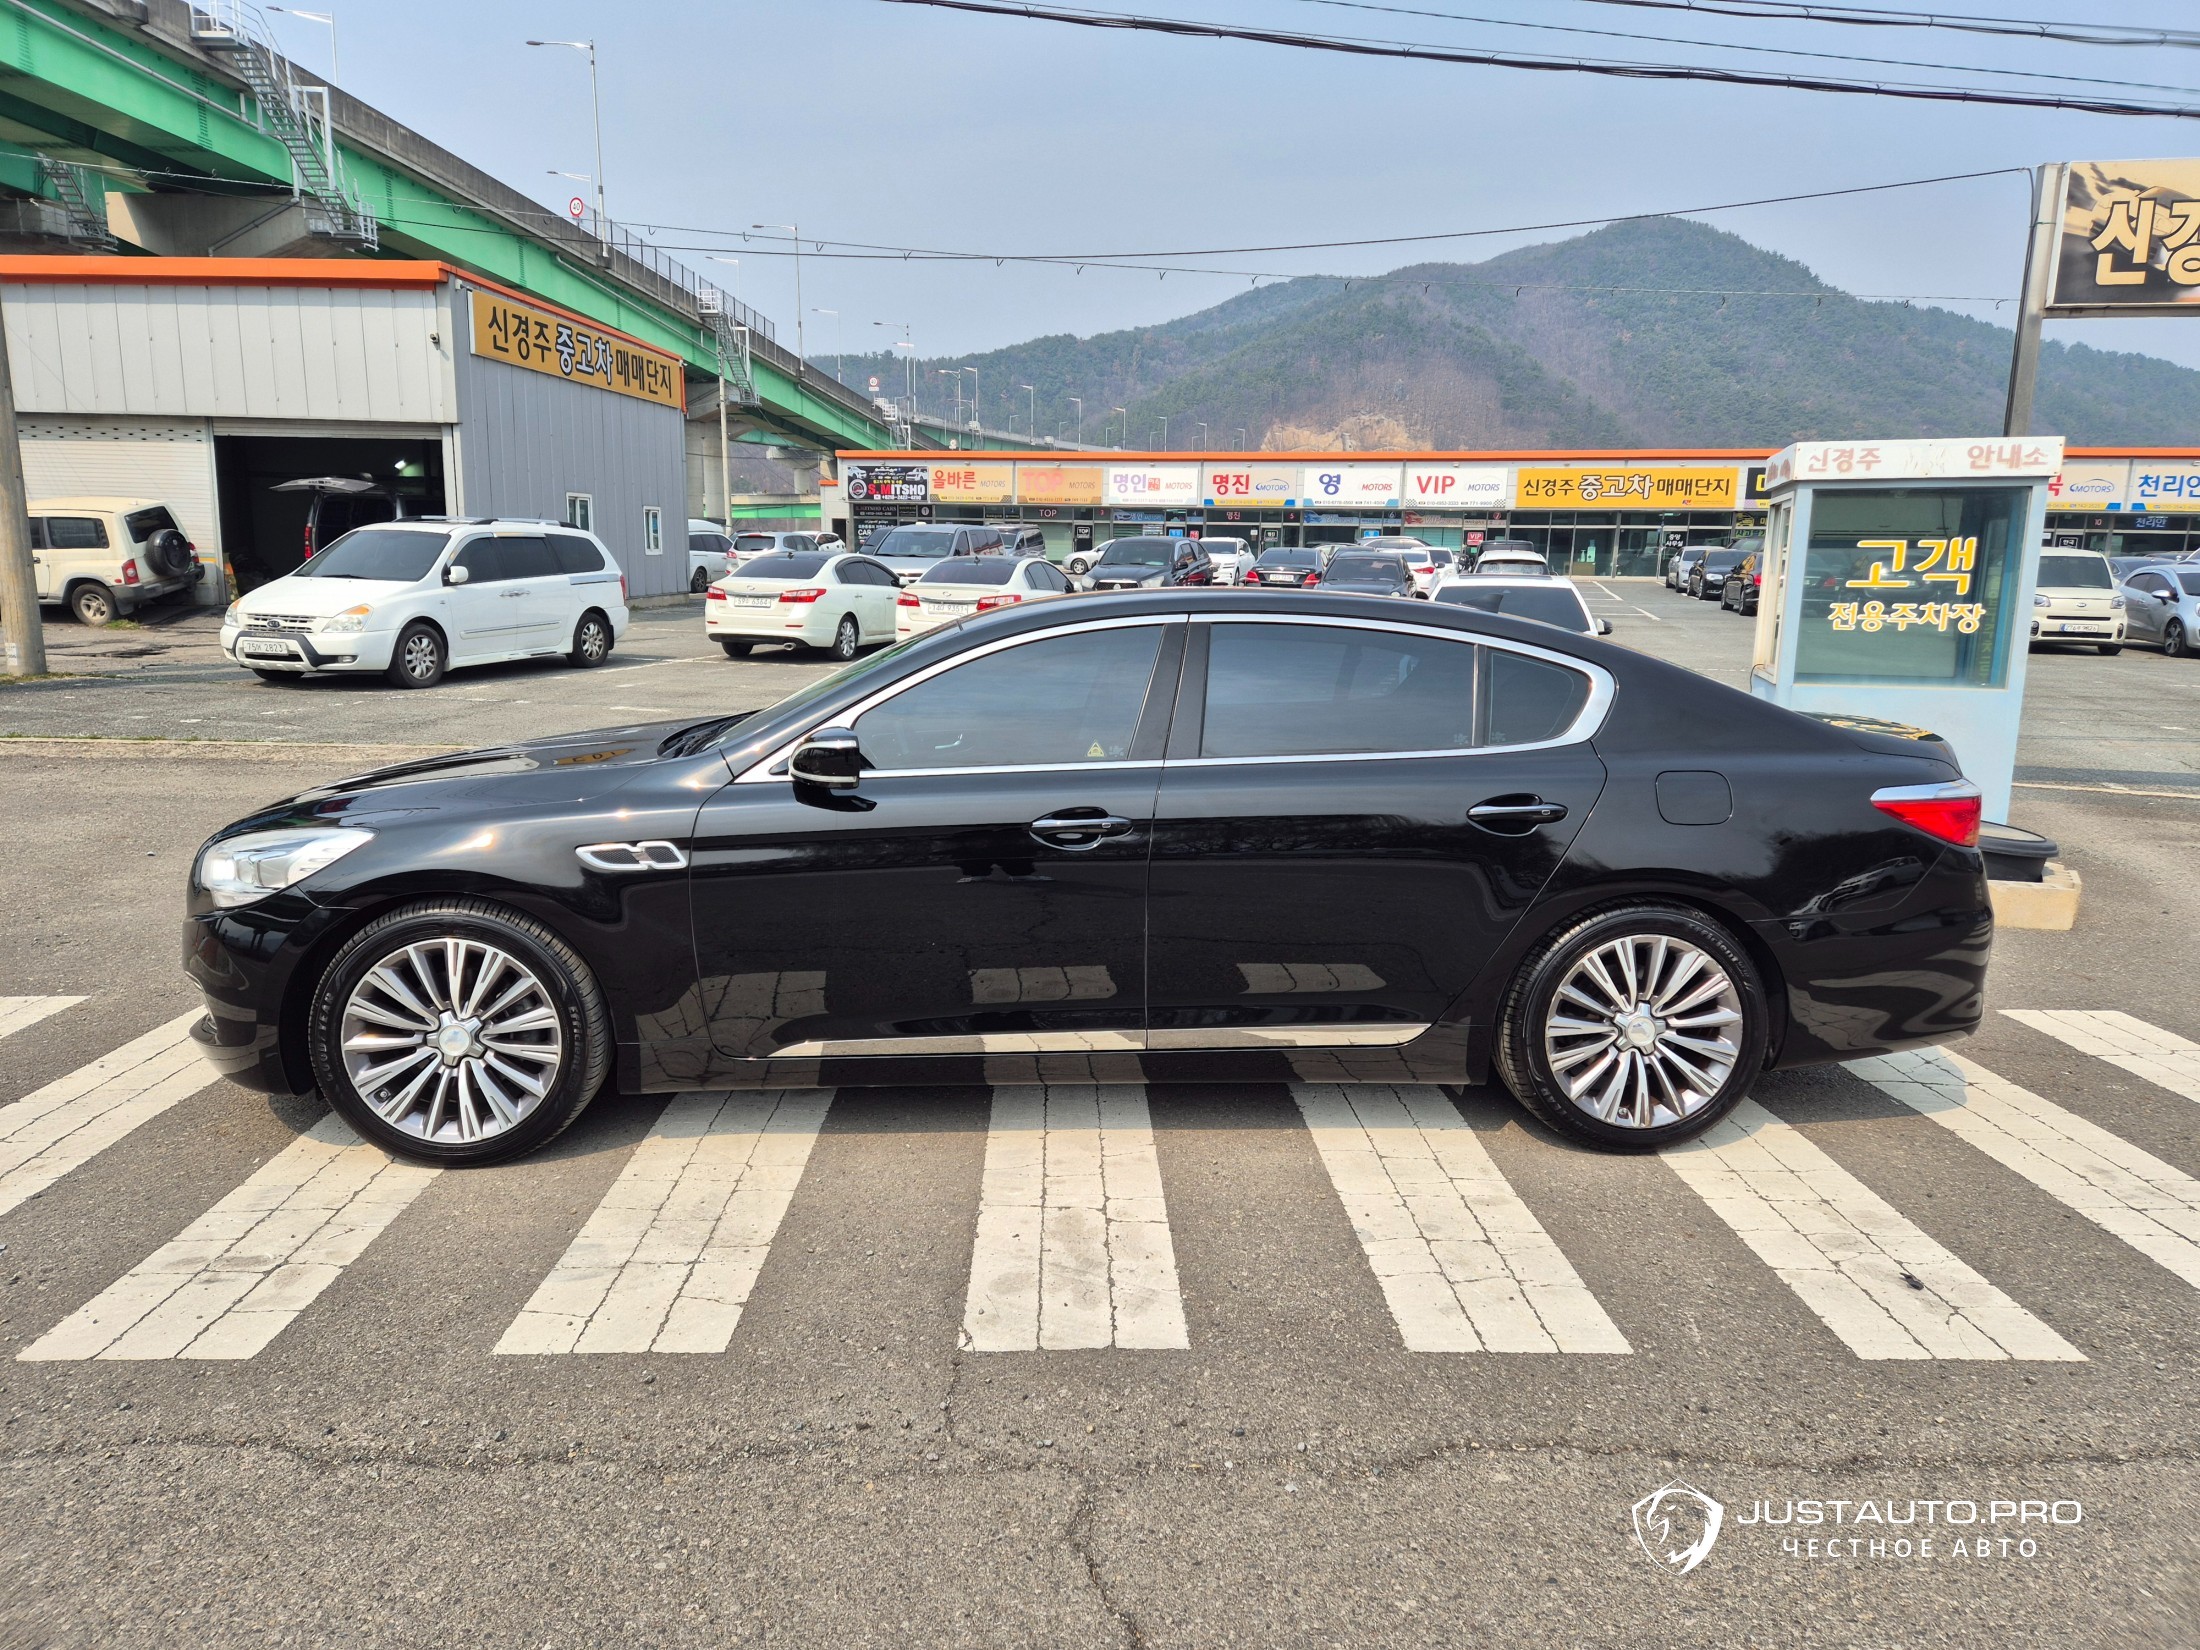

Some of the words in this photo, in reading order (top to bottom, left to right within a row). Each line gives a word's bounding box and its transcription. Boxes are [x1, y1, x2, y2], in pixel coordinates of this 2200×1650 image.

[488, 305, 552, 364] 신경주
[555, 322, 613, 386] 중고차
[616, 348, 672, 399] 매매단지
[1808, 447, 1882, 473] 신경주
[1967, 444, 2048, 470] 안내소
[932, 470, 976, 489] 올바른
[980, 480, 1006, 488] MOTORS
[1022, 471, 1064, 493] TOP
[1069, 481, 1096, 489] MOTORS
[1113, 473, 1147, 494] 명인
[1165, 482, 1193, 490] MOTORS
[1212, 473, 1250, 496] 명진
[1260, 484, 1287, 492] MOTORS
[1319, 473, 1341, 496] 영
[1361, 483, 1393, 491] MOTORS
[1416, 475, 1455, 494] VIP
[1467, 483, 1500, 492] MOTORS
[1523, 479, 1575, 497] 신경주
[1578, 474, 1654, 500] 중고차
[1657, 478, 1730, 497] 매매단지
[2075, 484, 2111, 493] MOTORS
[1039, 509, 1057, 517] TOP
[1226, 511, 1241, 520] 명진
[2135, 517, 2166, 528] 천리안
[1845, 536, 1978, 596] 고객
[1827, 600, 1987, 634] 전용주차장
[264, 643, 283, 652] 2823
